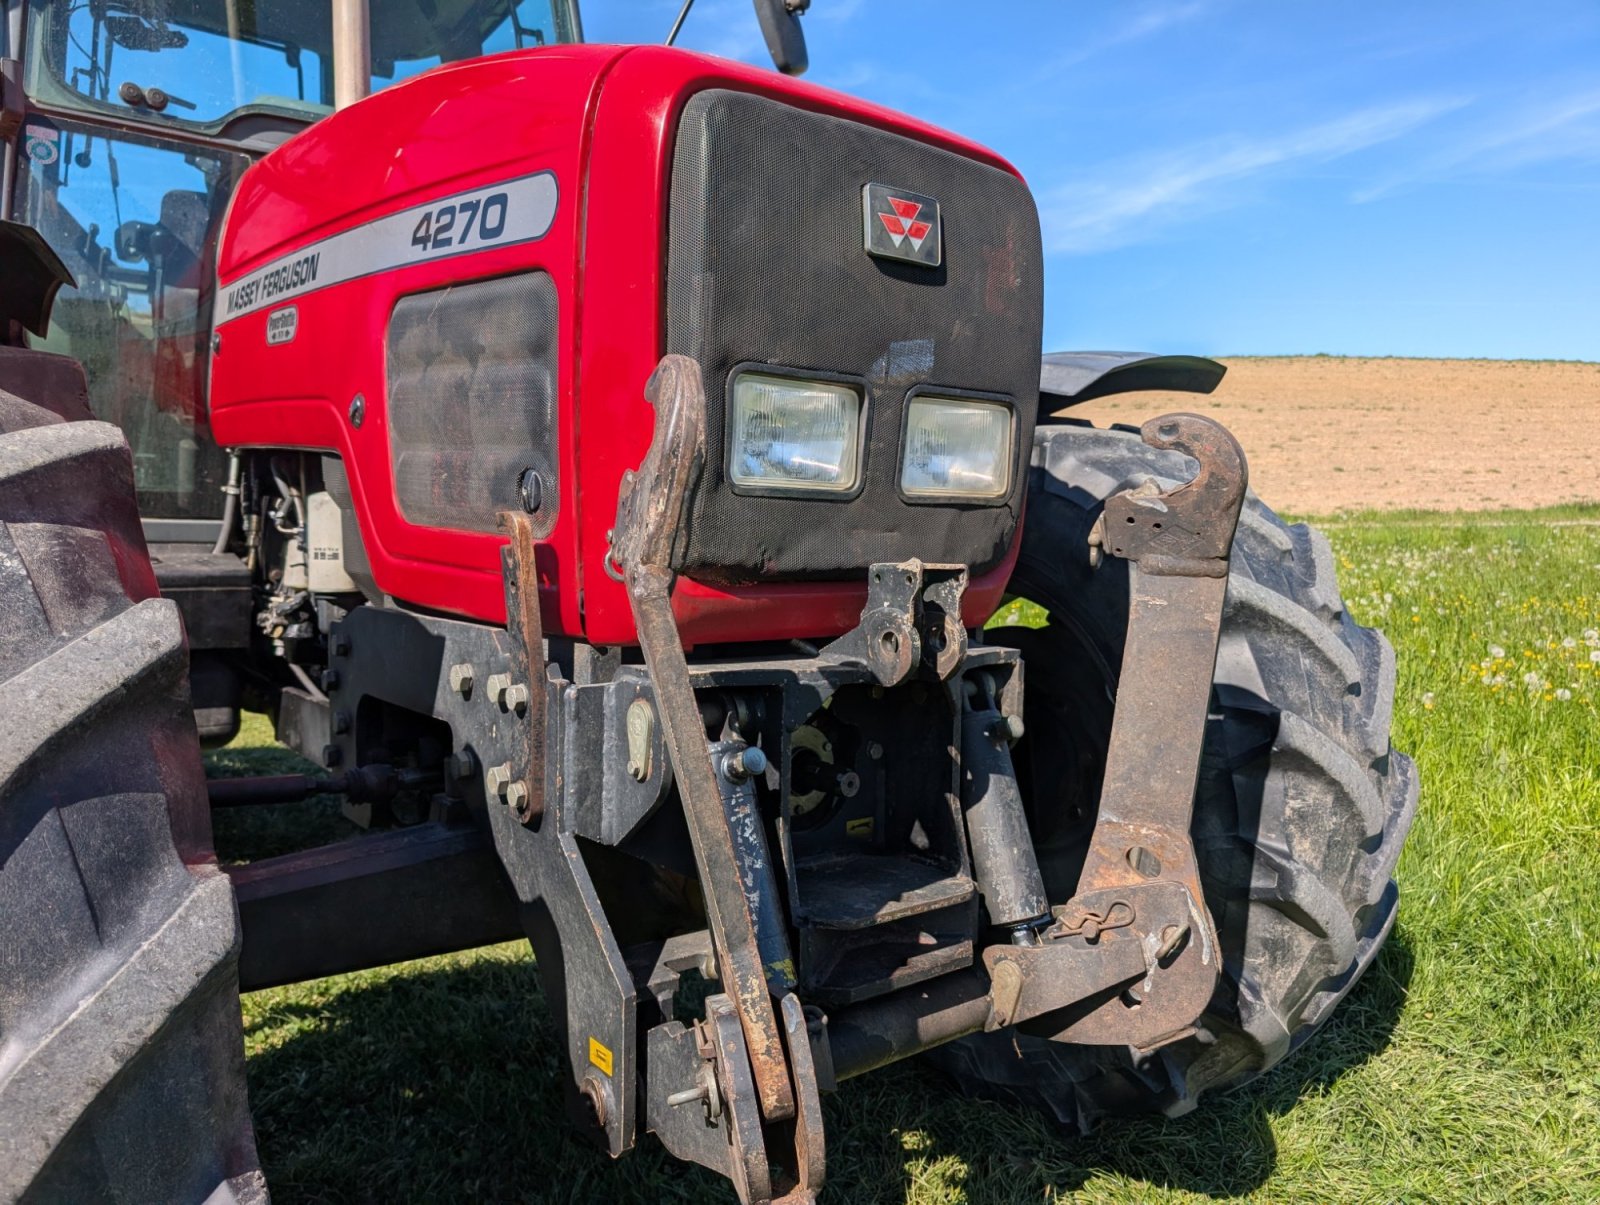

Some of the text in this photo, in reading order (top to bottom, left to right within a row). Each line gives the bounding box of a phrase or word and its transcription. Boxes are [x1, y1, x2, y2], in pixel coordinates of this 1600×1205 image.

[411, 192, 508, 251] 4270
[227, 252, 320, 315] MASSEY FERGUSON
